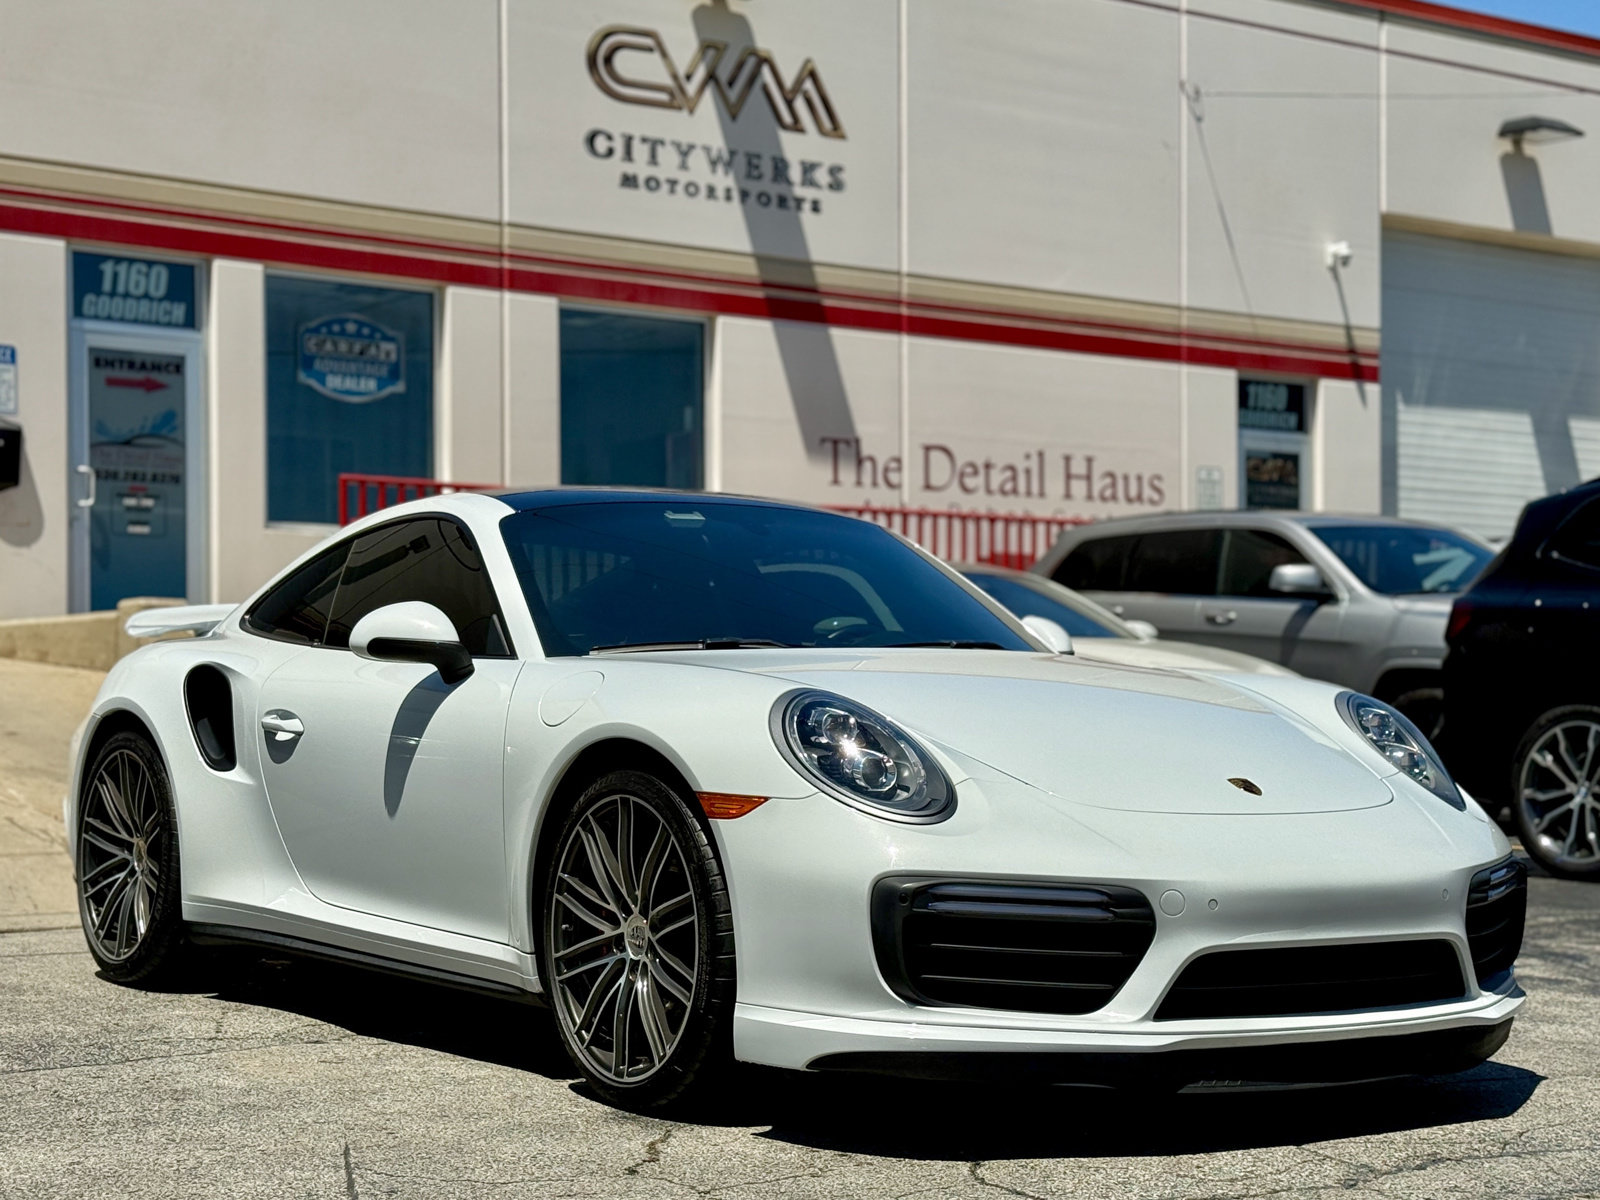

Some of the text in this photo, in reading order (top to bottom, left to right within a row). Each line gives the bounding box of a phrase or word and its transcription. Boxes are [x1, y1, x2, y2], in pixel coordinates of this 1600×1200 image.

[585, 128, 846, 192] CITYWERKS
[618, 172, 822, 215] MOTORSPORTS
[98, 259, 170, 300] 1160
[82, 292, 187, 326] GOODRICH
[93, 356, 183, 375] ENTRANCE
[325, 373, 379, 393] DEALER
[820, 436, 903, 490] The
[920, 443, 1046, 500] Detail
[1062, 453, 1166, 507] Haus
